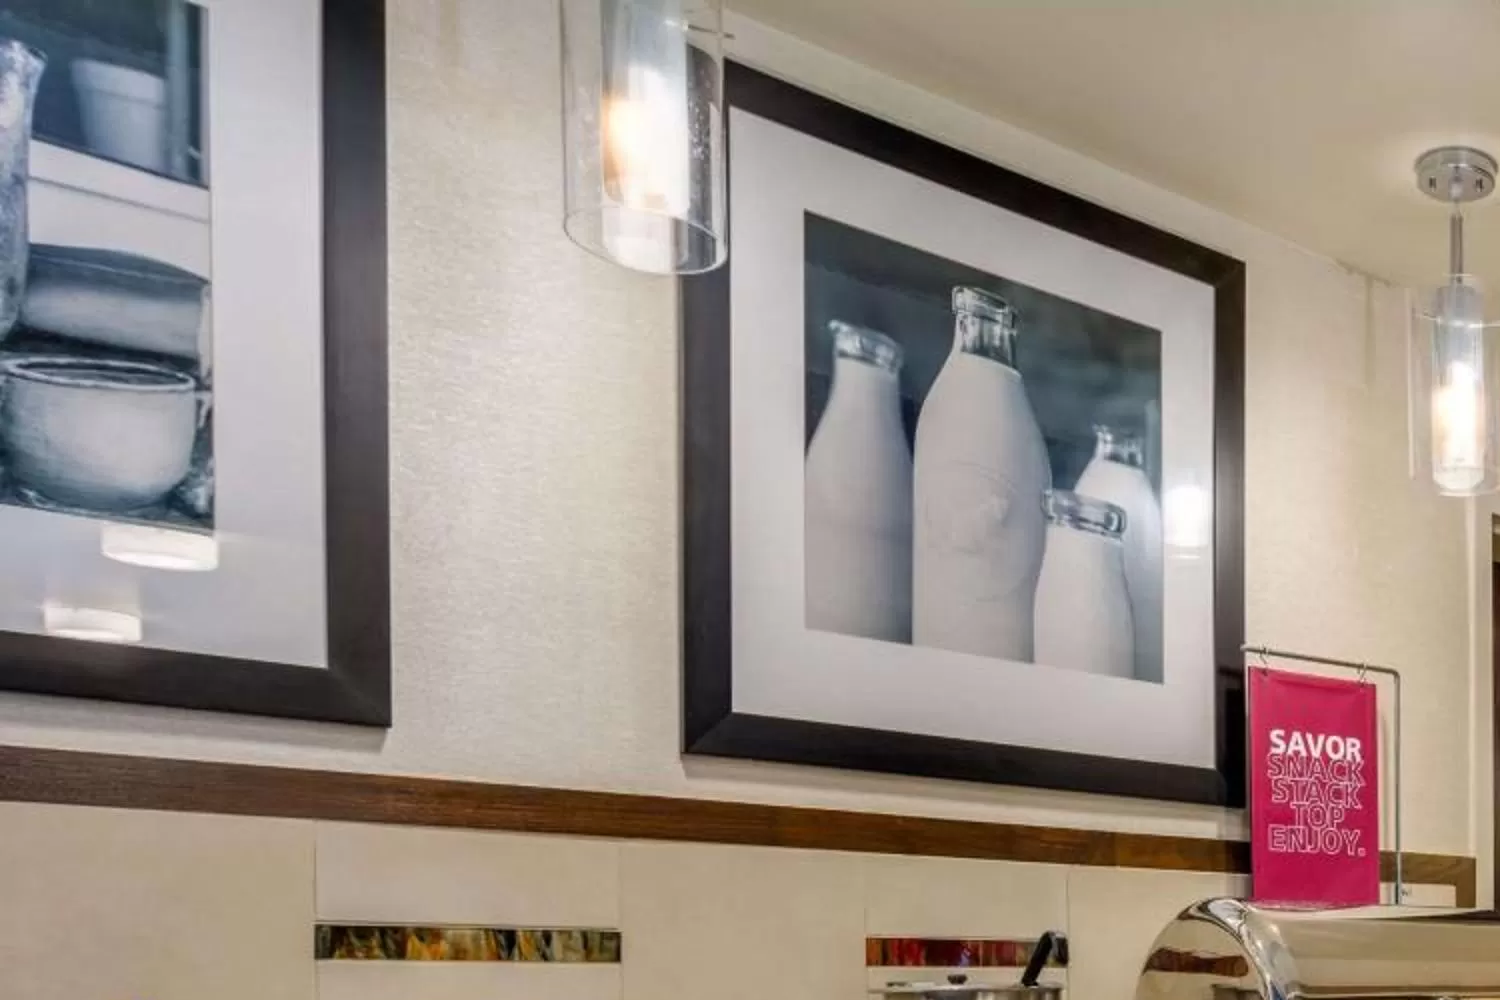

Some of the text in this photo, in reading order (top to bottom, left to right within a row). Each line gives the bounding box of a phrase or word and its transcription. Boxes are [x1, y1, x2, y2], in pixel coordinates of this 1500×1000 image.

[1269, 728, 1362, 762] SAVOR
[1267, 751, 1366, 787] SNACK
[1271, 776, 1363, 810] STACK
[1290, 800, 1345, 831] TOP
[1268, 823, 1366, 857] ENJOY.
